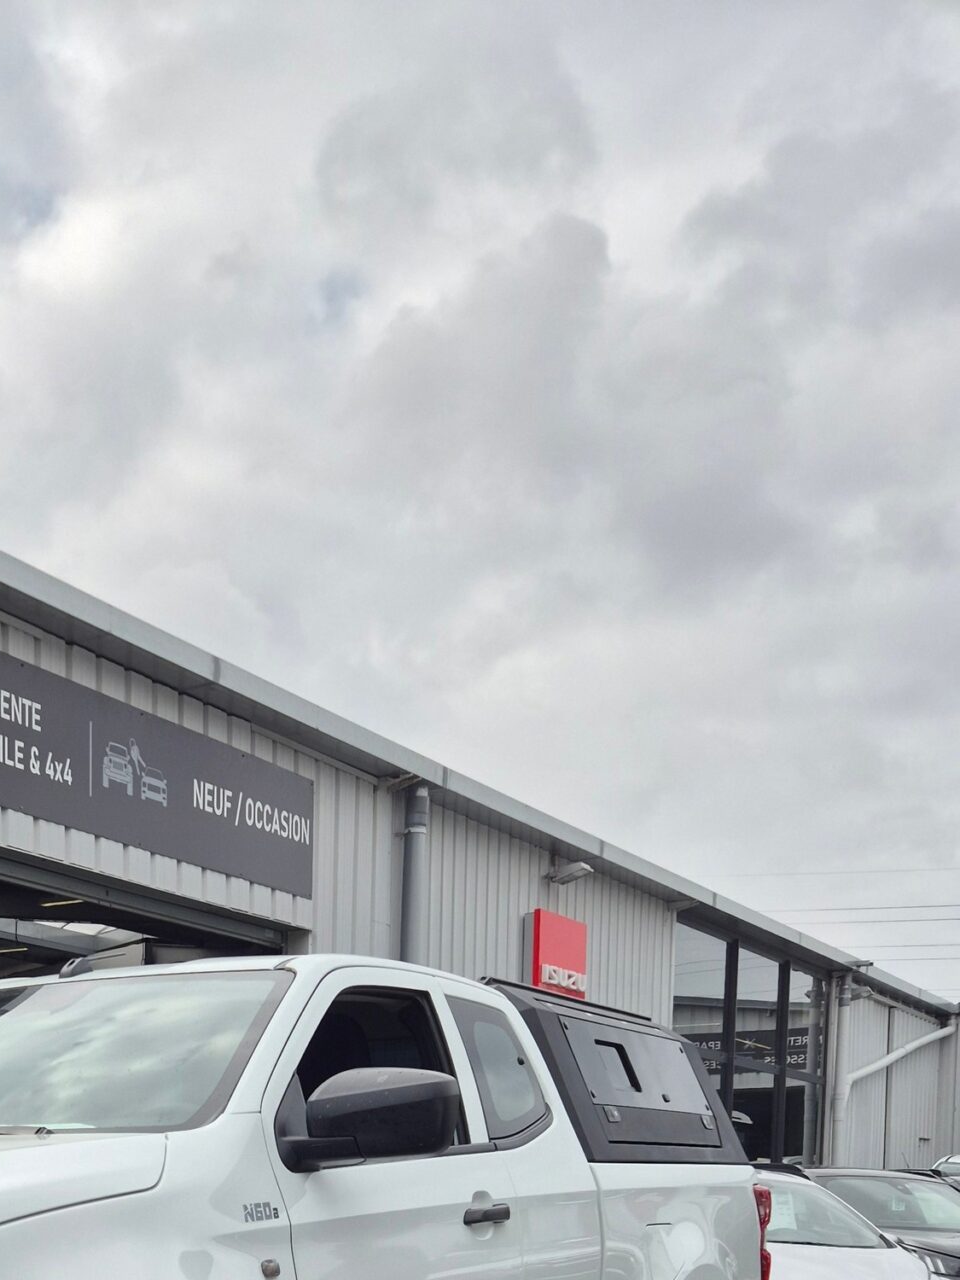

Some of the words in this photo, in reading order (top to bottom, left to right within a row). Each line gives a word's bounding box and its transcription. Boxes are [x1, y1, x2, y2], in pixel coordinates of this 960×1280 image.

[29, 745, 41, 776] &
[45, 751, 73, 786] 4x4
[193, 778, 233, 818] NEUF
[245, 797, 310, 846] OCCASION
[541, 963, 587, 992] ISUZU
